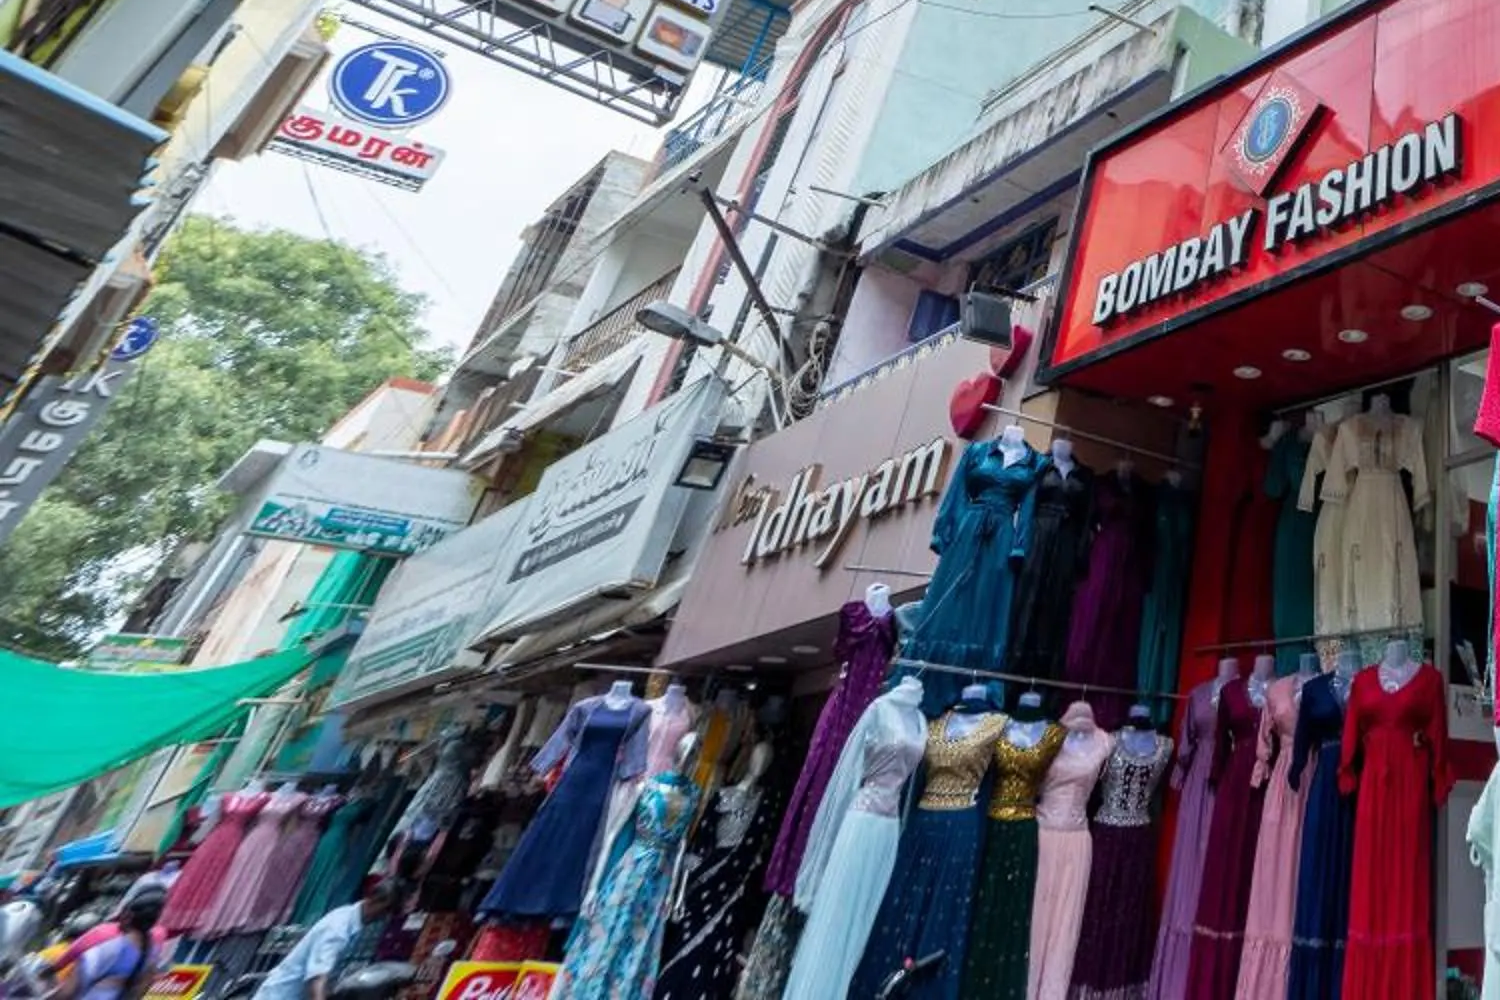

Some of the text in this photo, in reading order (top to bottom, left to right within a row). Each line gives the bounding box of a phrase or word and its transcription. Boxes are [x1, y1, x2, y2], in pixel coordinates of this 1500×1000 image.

[1092, 113, 1461, 326] BOMBAY FASHION
[740, 436, 949, 569] Idhayam
